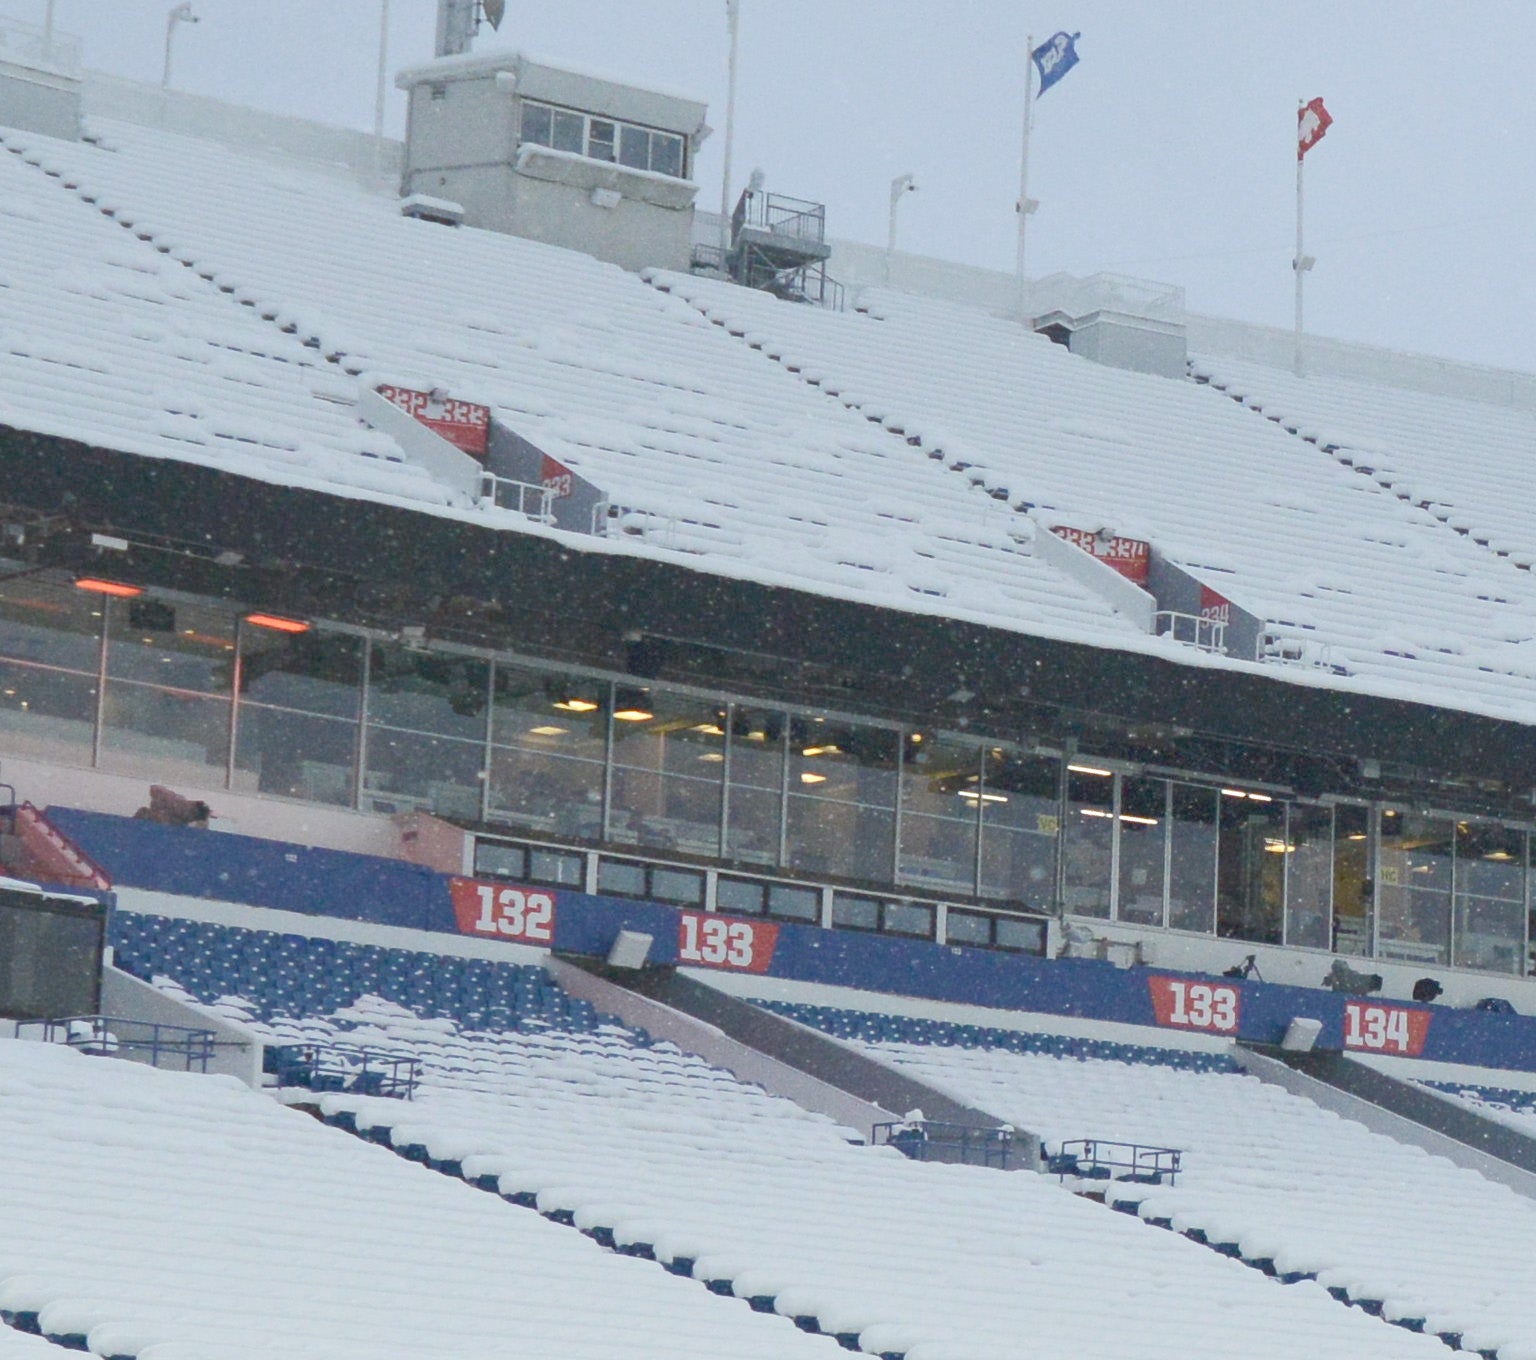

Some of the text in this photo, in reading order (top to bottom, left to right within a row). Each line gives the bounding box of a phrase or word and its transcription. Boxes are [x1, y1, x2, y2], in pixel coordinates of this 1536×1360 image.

[475, 885, 552, 940] 132
[680, 915, 754, 967] 133
[1170, 982, 1236, 1031] 133
[1345, 1004, 1409, 1051] 134
